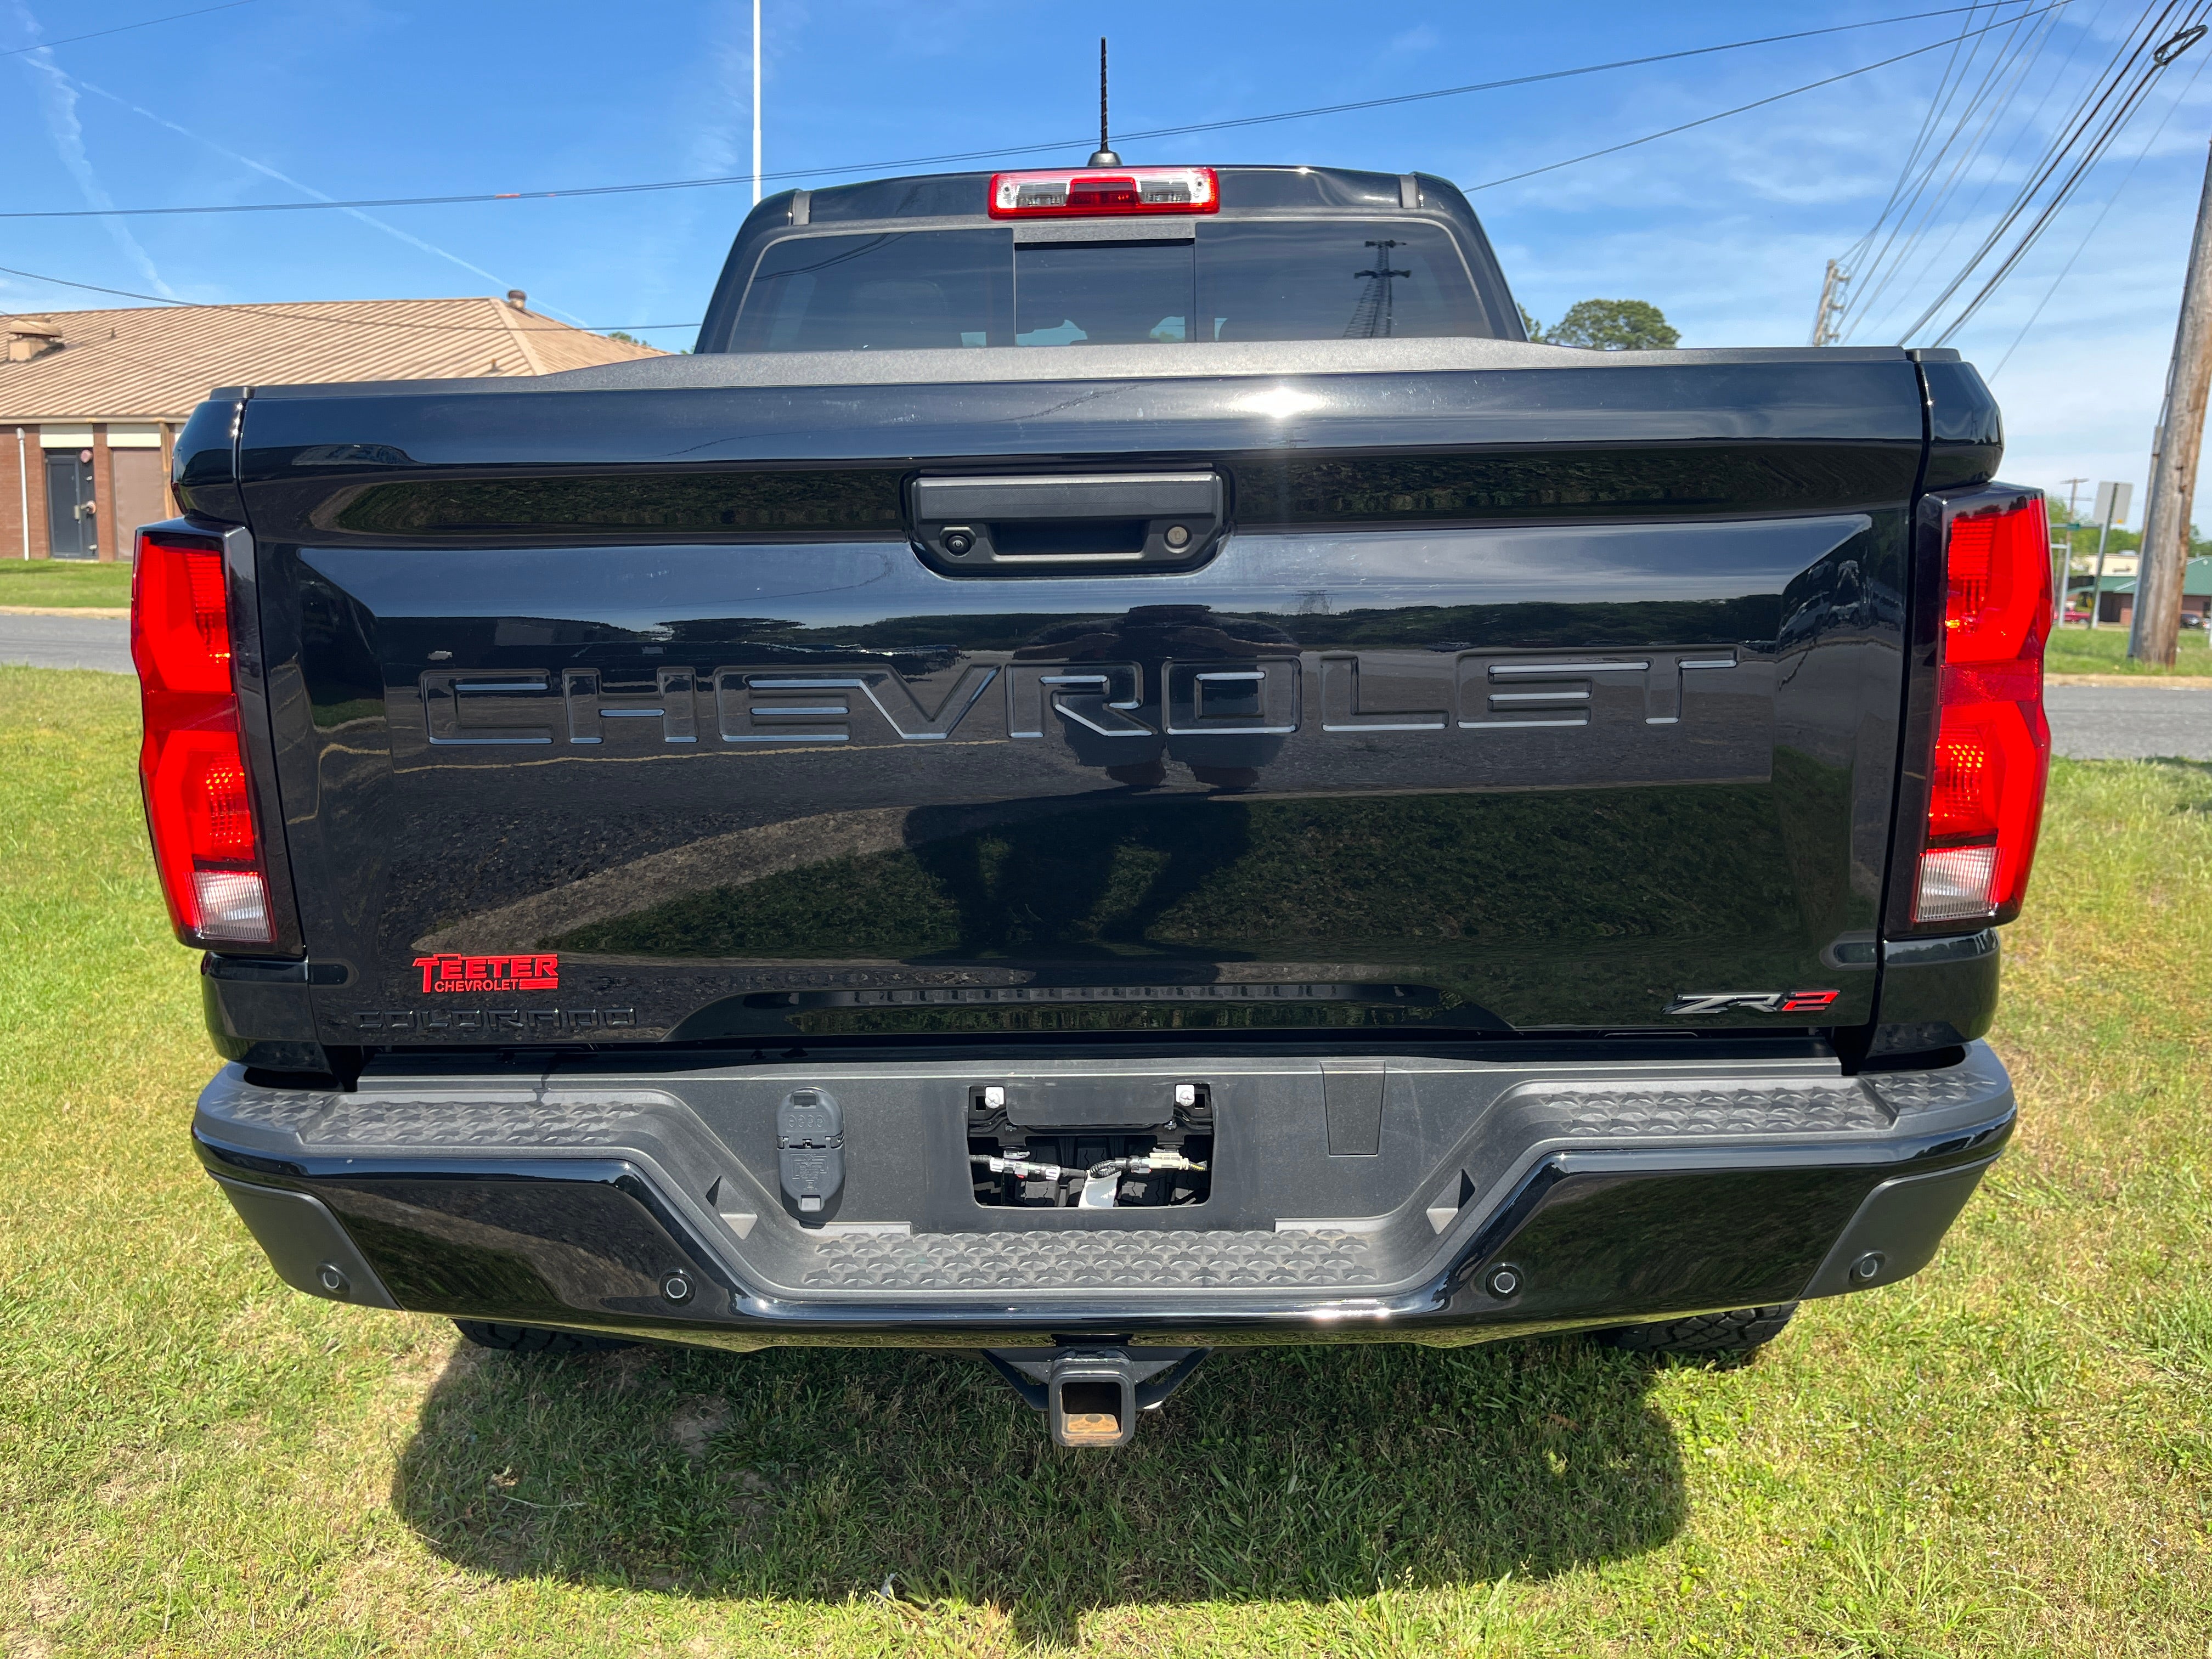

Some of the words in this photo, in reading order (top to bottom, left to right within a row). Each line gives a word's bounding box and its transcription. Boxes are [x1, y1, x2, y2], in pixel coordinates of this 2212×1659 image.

[419, 645, 1739, 744] CHEVROLET
[413, 953, 558, 992] TEETER
[435, 979, 519, 992] CHEVROLET
[1661, 990, 1840, 1014] ZR2
[354, 1007, 637, 1029] COLORADO
